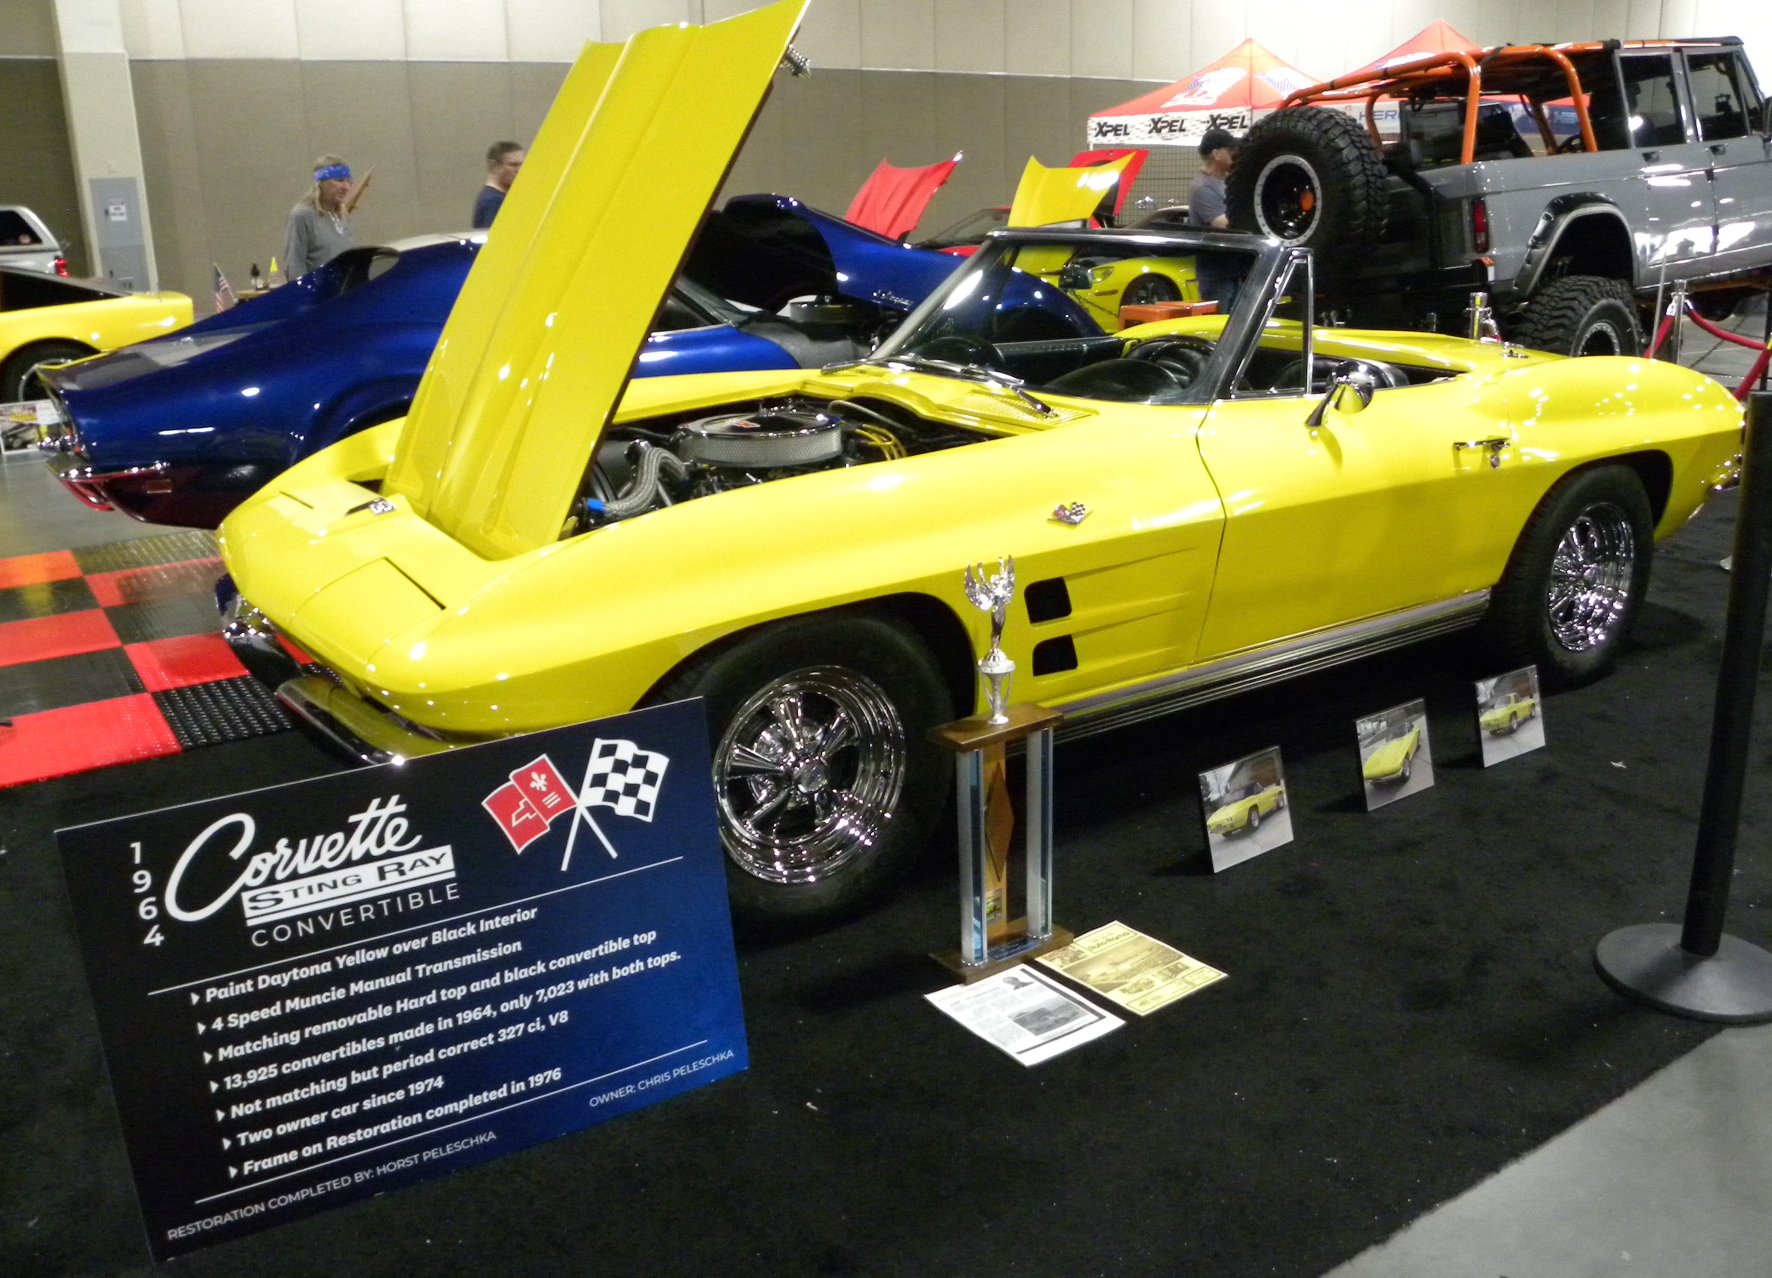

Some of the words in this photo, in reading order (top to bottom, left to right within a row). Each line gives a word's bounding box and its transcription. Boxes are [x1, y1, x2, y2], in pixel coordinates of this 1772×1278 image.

[1095, 122, 1131, 137] XPEL
[1148, 117, 1187, 134] XPEL
[1206, 114, 1249, 131] XPEL
[164, 794, 422, 922] Corvette
[377, 852, 448, 882] RAY
[205, 979, 254, 1003] Paint
[257, 961, 332, 990] Daytona
[335, 946, 390, 969] Yellow
[392, 936, 429, 955] over
[431, 921, 477, 945] Black
[479, 907, 538, 932] Interior
[251, 882, 460, 947] CONVERTIBLE
[211, 1016, 225, 1031] 4
[227, 1000, 282, 1029] Speed
[285, 986, 347, 1013] Muncie
[349, 966, 412, 996] Manual
[414, 941, 523, 978] Transmission
[218, 1029, 301, 1062] Matching
[304, 1004, 393, 1038] removable
[396, 989, 438, 1013] Hard
[439, 985, 468, 1001] top
[469, 972, 501, 993] and
[504, 960, 547, 984] black
[548, 937, 631, 970] convertible
[632, 930, 657, 946] top
[223, 1063, 279, 1090] 13,925
[281, 1037, 386, 1074] convertibles
[388, 1022, 435, 1045] made
[437, 1017, 454, 1031] in
[456, 1004, 497, 1025] 1964,
[500, 993, 533, 1013] only
[535, 980, 575, 1003] 7,023
[577, 970, 610, 990] with
[612, 959, 645, 980] both
[646, 951, 681, 969] tops.
[230, 1099, 263, 1119] Not
[265, 1076, 348, 1109] matching
[350, 1066, 380, 1085] but
[382, 1048, 435, 1079] period
[437, 1033, 495, 1060] correct
[497, 1022, 525, 1042] 327
[527, 1017, 546, 1033] ci,
[548, 1010, 569, 1026] V8
[589, 1084, 637, 1107] OWNER:
[637, 1071, 671, 1091] CHRIS
[672, 1049, 735, 1078] PELESCHKA
[236, 1128, 274, 1146] Two
[276, 1111, 329, 1136] owner
[330, 1102, 360, 1119] car
[362, 1089, 406, 1110] since
[407, 1075, 445, 1097] 1974
[243, 1150, 299, 1175] Frame
[301, 1142, 324, 1157] on
[326, 1112, 423, 1150] Restoration
[425, 1083, 508, 1120] completed
[510, 1080, 526, 1094] in
[527, 1067, 562, 1088] 1976
[166, 1202, 266, 1241] RESTORATION
[267, 1175, 352, 1210] COMPLETED
[353, 1168, 374, 1183] BY:
[376, 1153, 420, 1176] HORST
[422, 1131, 497, 1162] PELESCHKA
